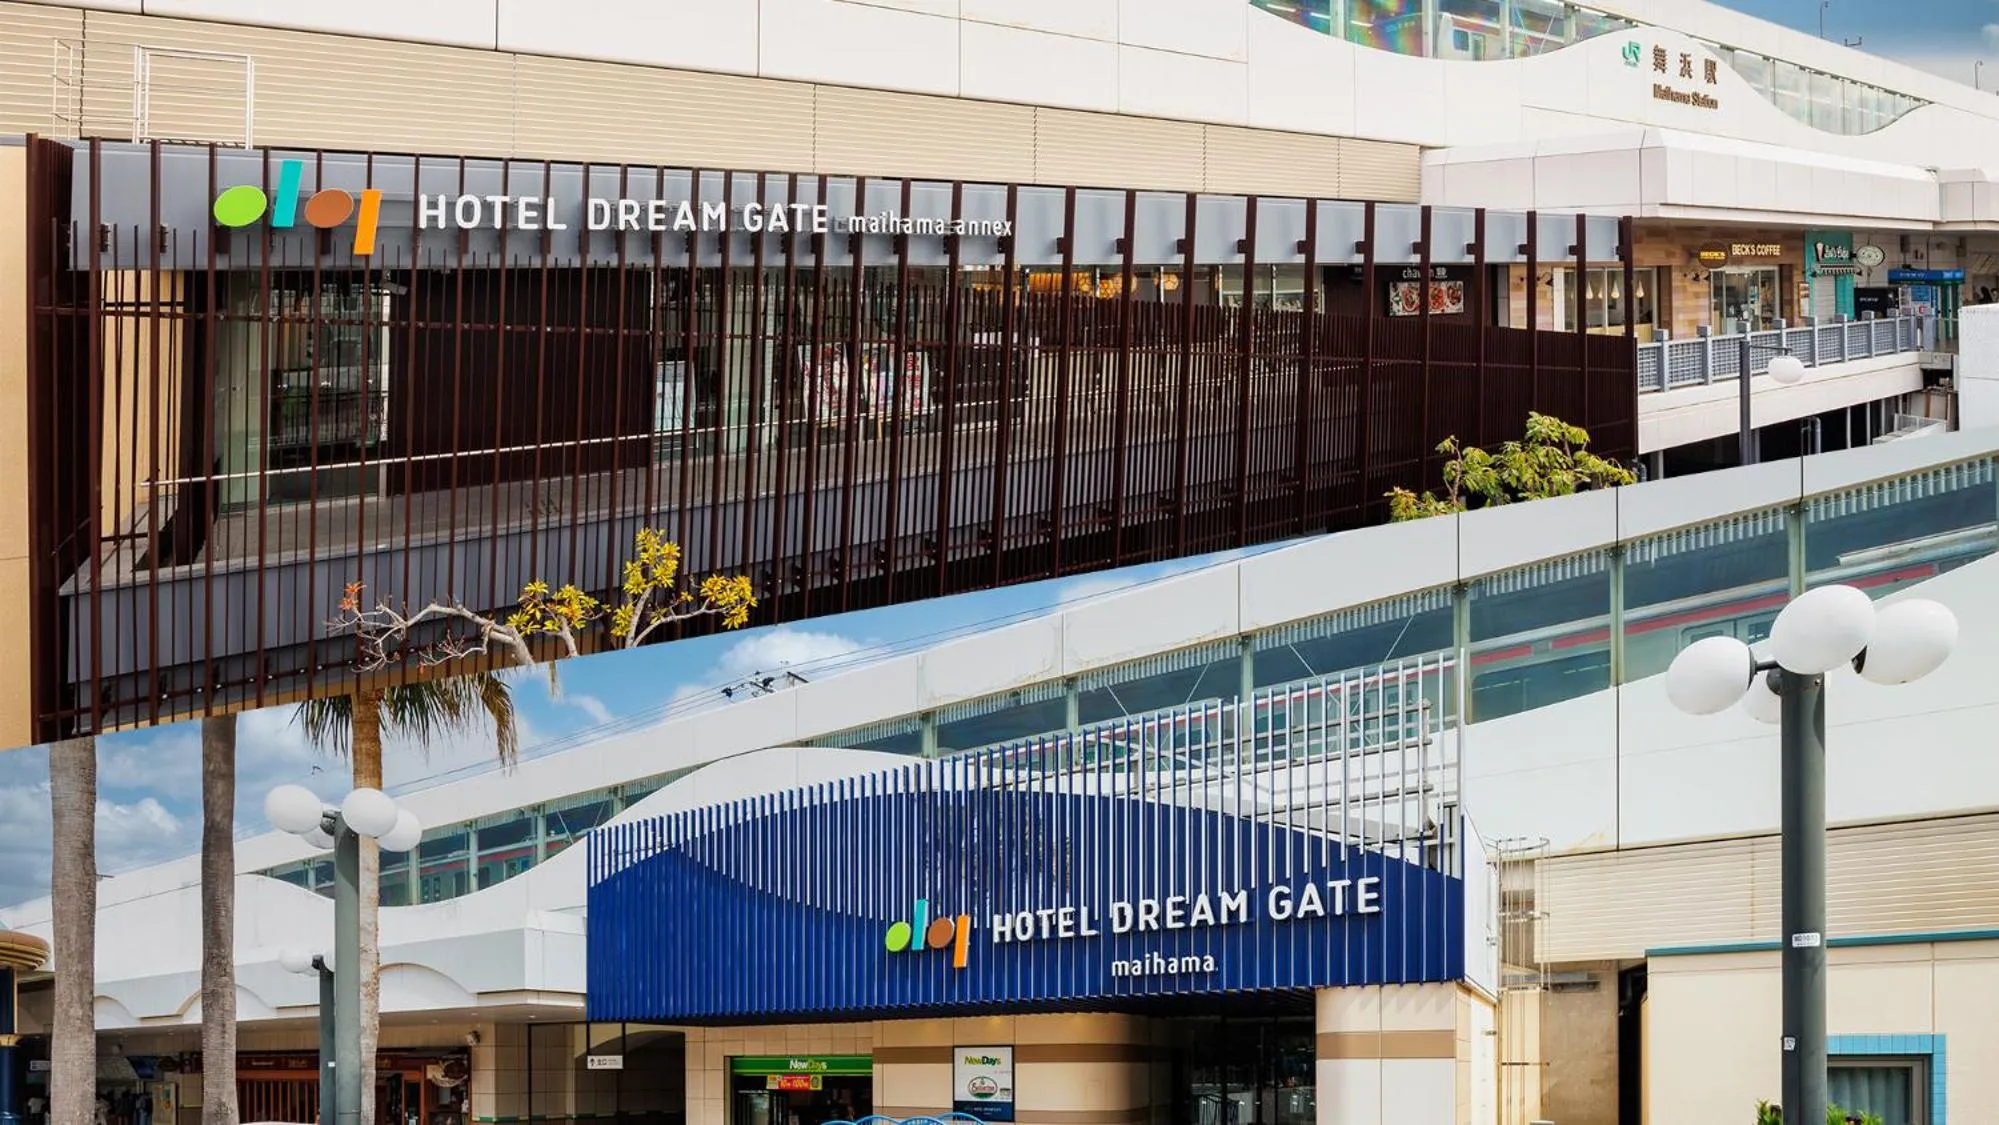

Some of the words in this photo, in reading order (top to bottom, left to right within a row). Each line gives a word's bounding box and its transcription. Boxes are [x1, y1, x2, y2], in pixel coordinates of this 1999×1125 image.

[1622, 41, 1640, 62] JR
[1653, 44, 1717, 84] 舞浜駅
[419, 194, 568, 230] HOTEL
[587, 198, 727, 232] DREAM
[743, 202, 829, 233] GATE
[849, 209, 945, 236] maihama
[955, 219, 1013, 236] annex
[1757, 244, 1781, 256] COFFEE
[993, 905, 1100, 943] HOTEL
[1112, 889, 1249, 934] DREAM
[1268, 876, 1381, 921] GATE
[1111, 952, 1215, 977] maihama
[789, 1059, 828, 1071] NewDays
[964, 1055, 1002, 1066] NewDays
